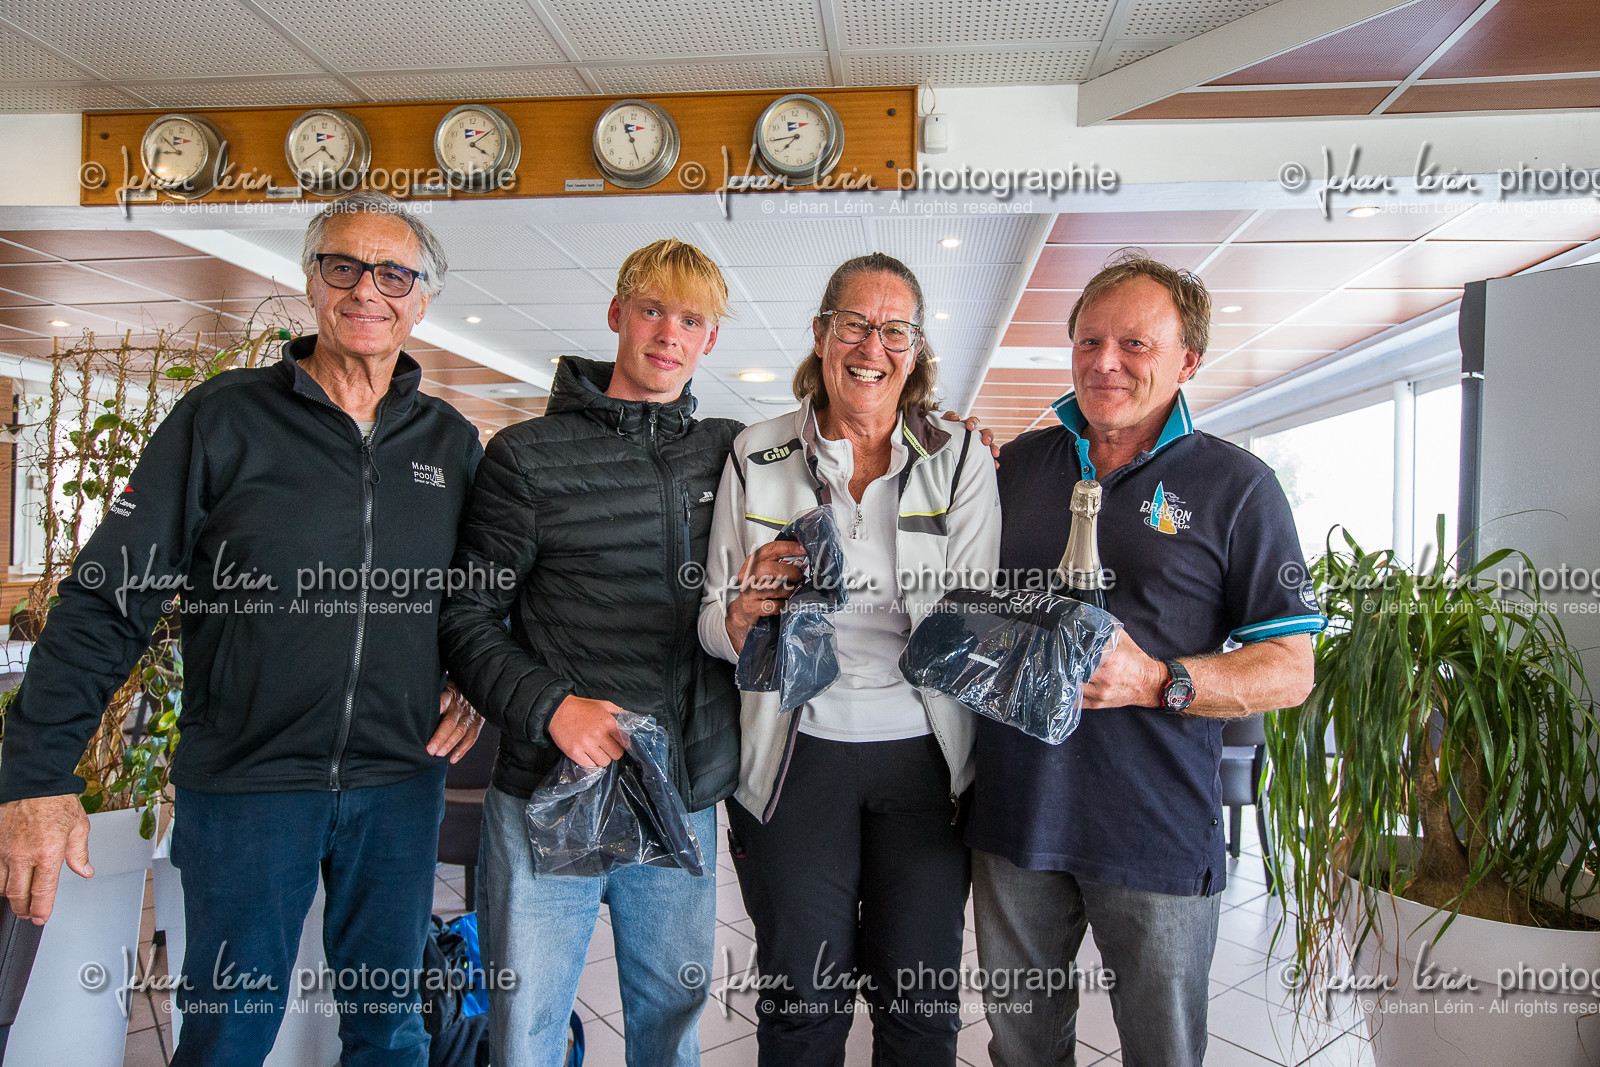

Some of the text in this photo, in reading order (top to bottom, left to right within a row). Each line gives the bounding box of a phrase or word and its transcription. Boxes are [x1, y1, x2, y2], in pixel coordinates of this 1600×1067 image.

[763, 446, 790, 461] Gill
[411, 461, 443, 475] MARINE
[414, 471, 434, 481] POOL
[1140, 500, 1193, 522] DRAGON
